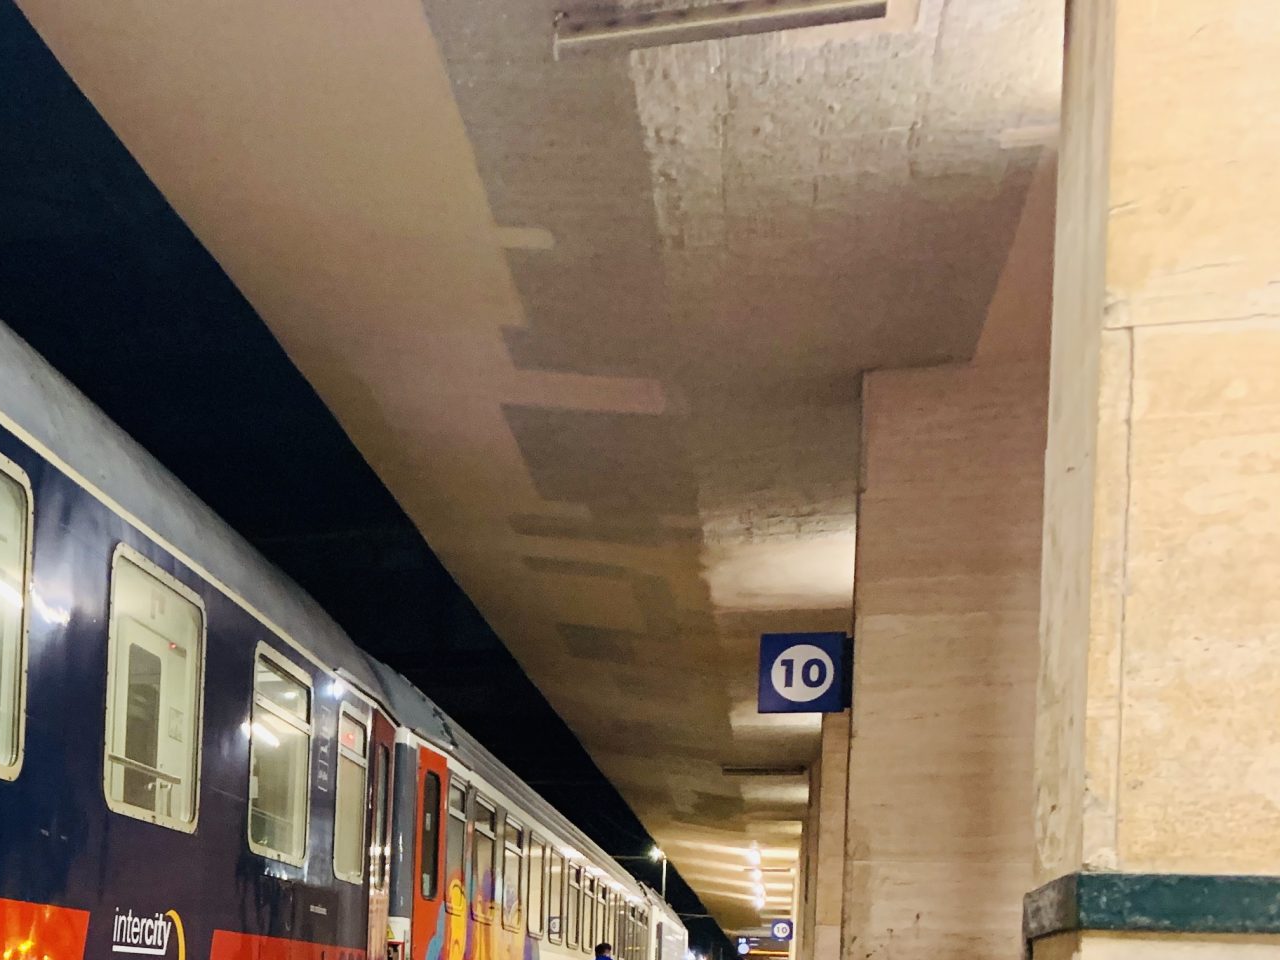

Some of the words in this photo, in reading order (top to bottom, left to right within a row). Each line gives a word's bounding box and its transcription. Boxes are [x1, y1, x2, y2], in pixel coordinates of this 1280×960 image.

[781, 658, 827, 688] 10
[112, 906, 172, 955] intercity
[776, 926, 788, 934] 10
